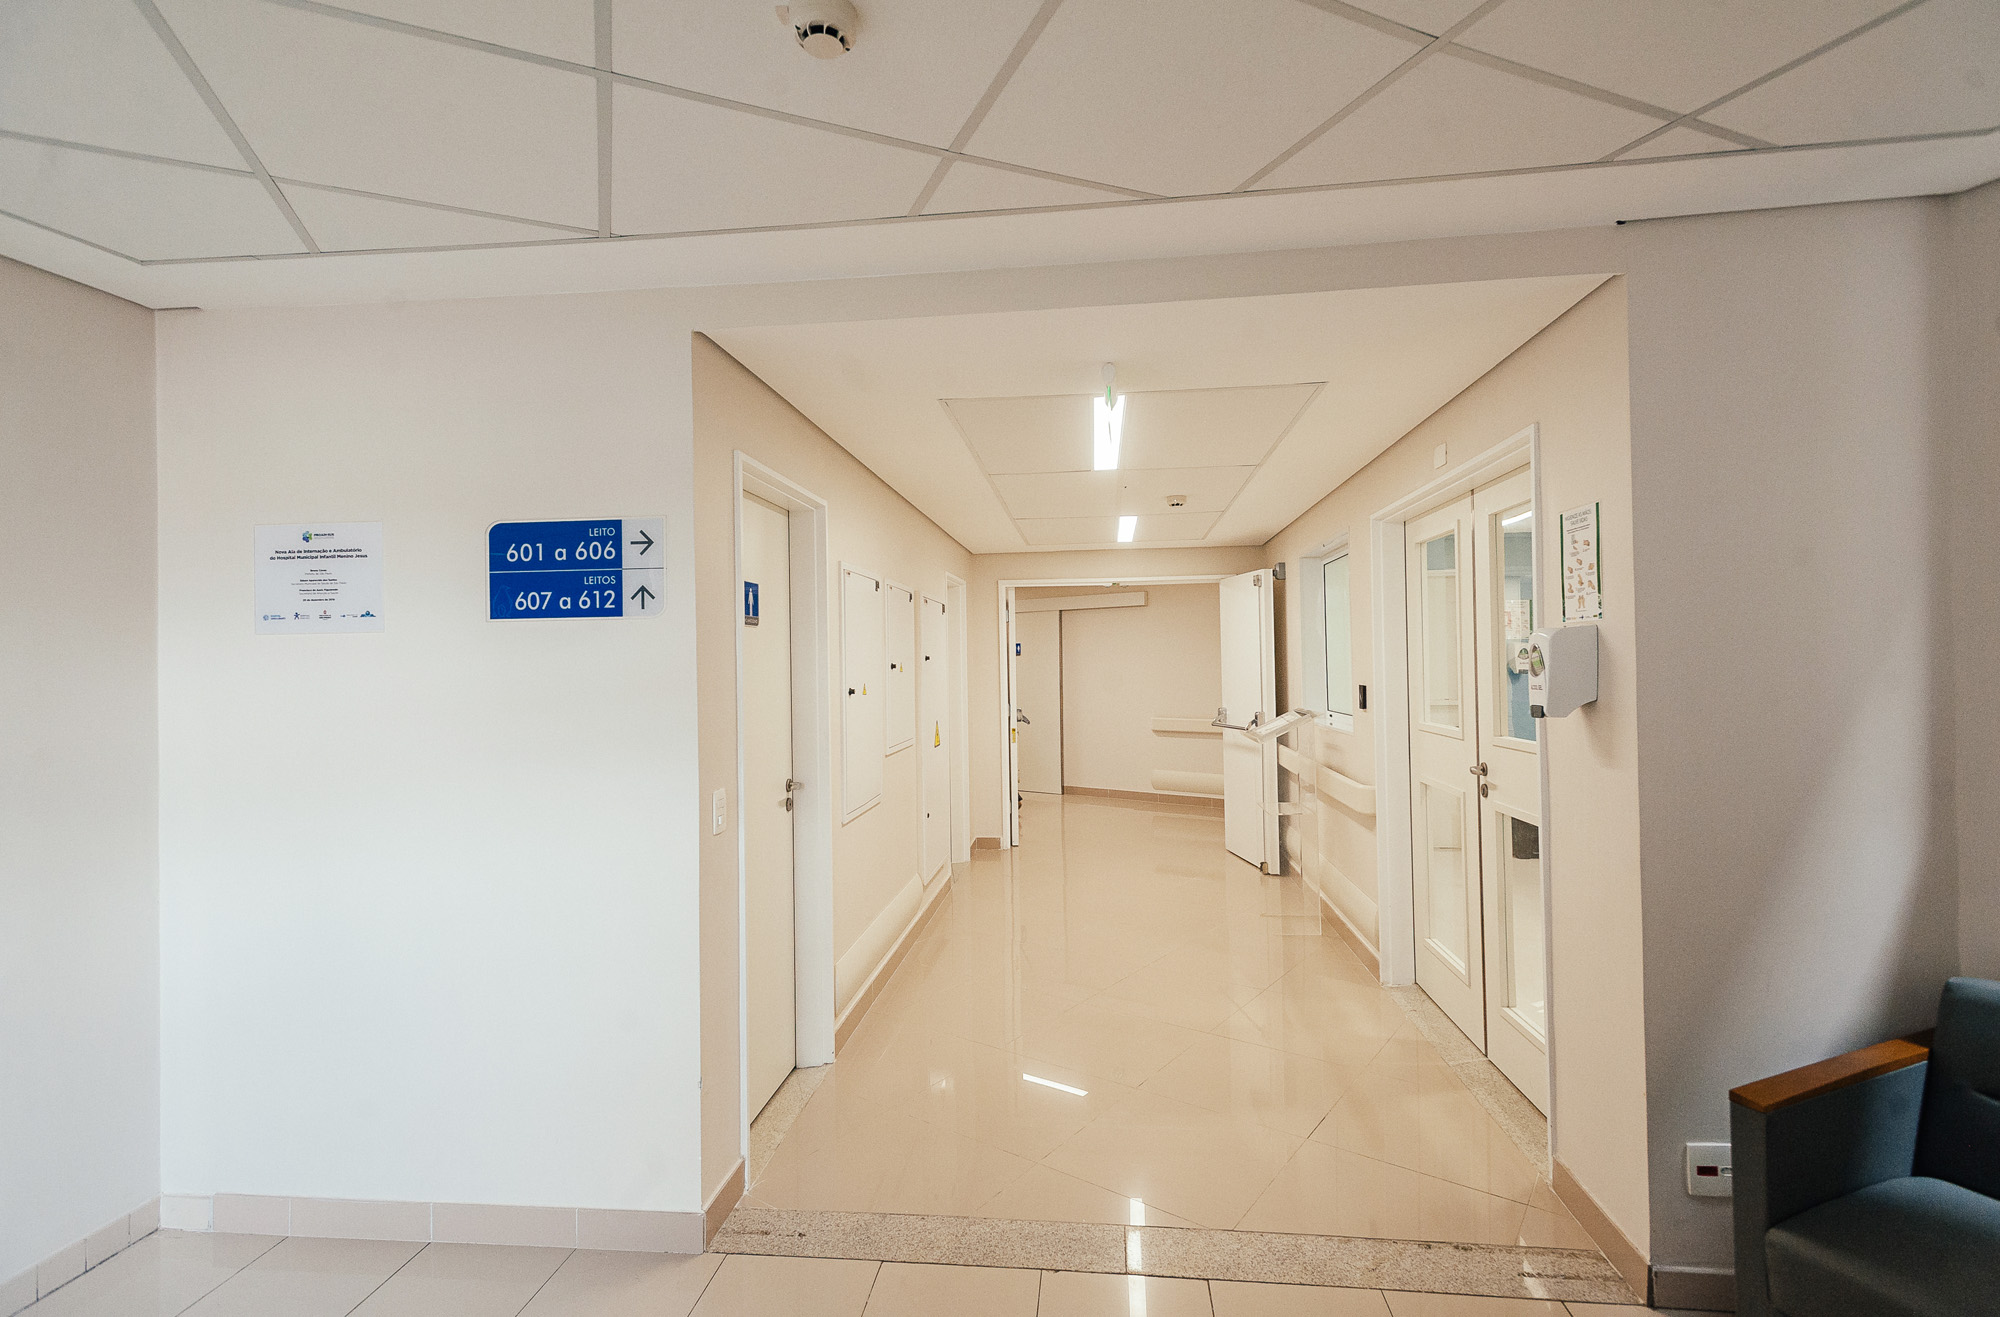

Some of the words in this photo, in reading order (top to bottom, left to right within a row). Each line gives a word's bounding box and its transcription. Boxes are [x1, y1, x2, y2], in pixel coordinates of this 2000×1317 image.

[589, 527, 616, 537] LEITO
[506, 543, 543, 562] 601
[554, 547, 567, 561] a
[575, 540, 616, 560] 606
[584, 575, 617, 585] LEITOS
[515, 591, 552, 611] 607
[559, 596, 571, 609] a
[578, 589, 616, 609] 612
